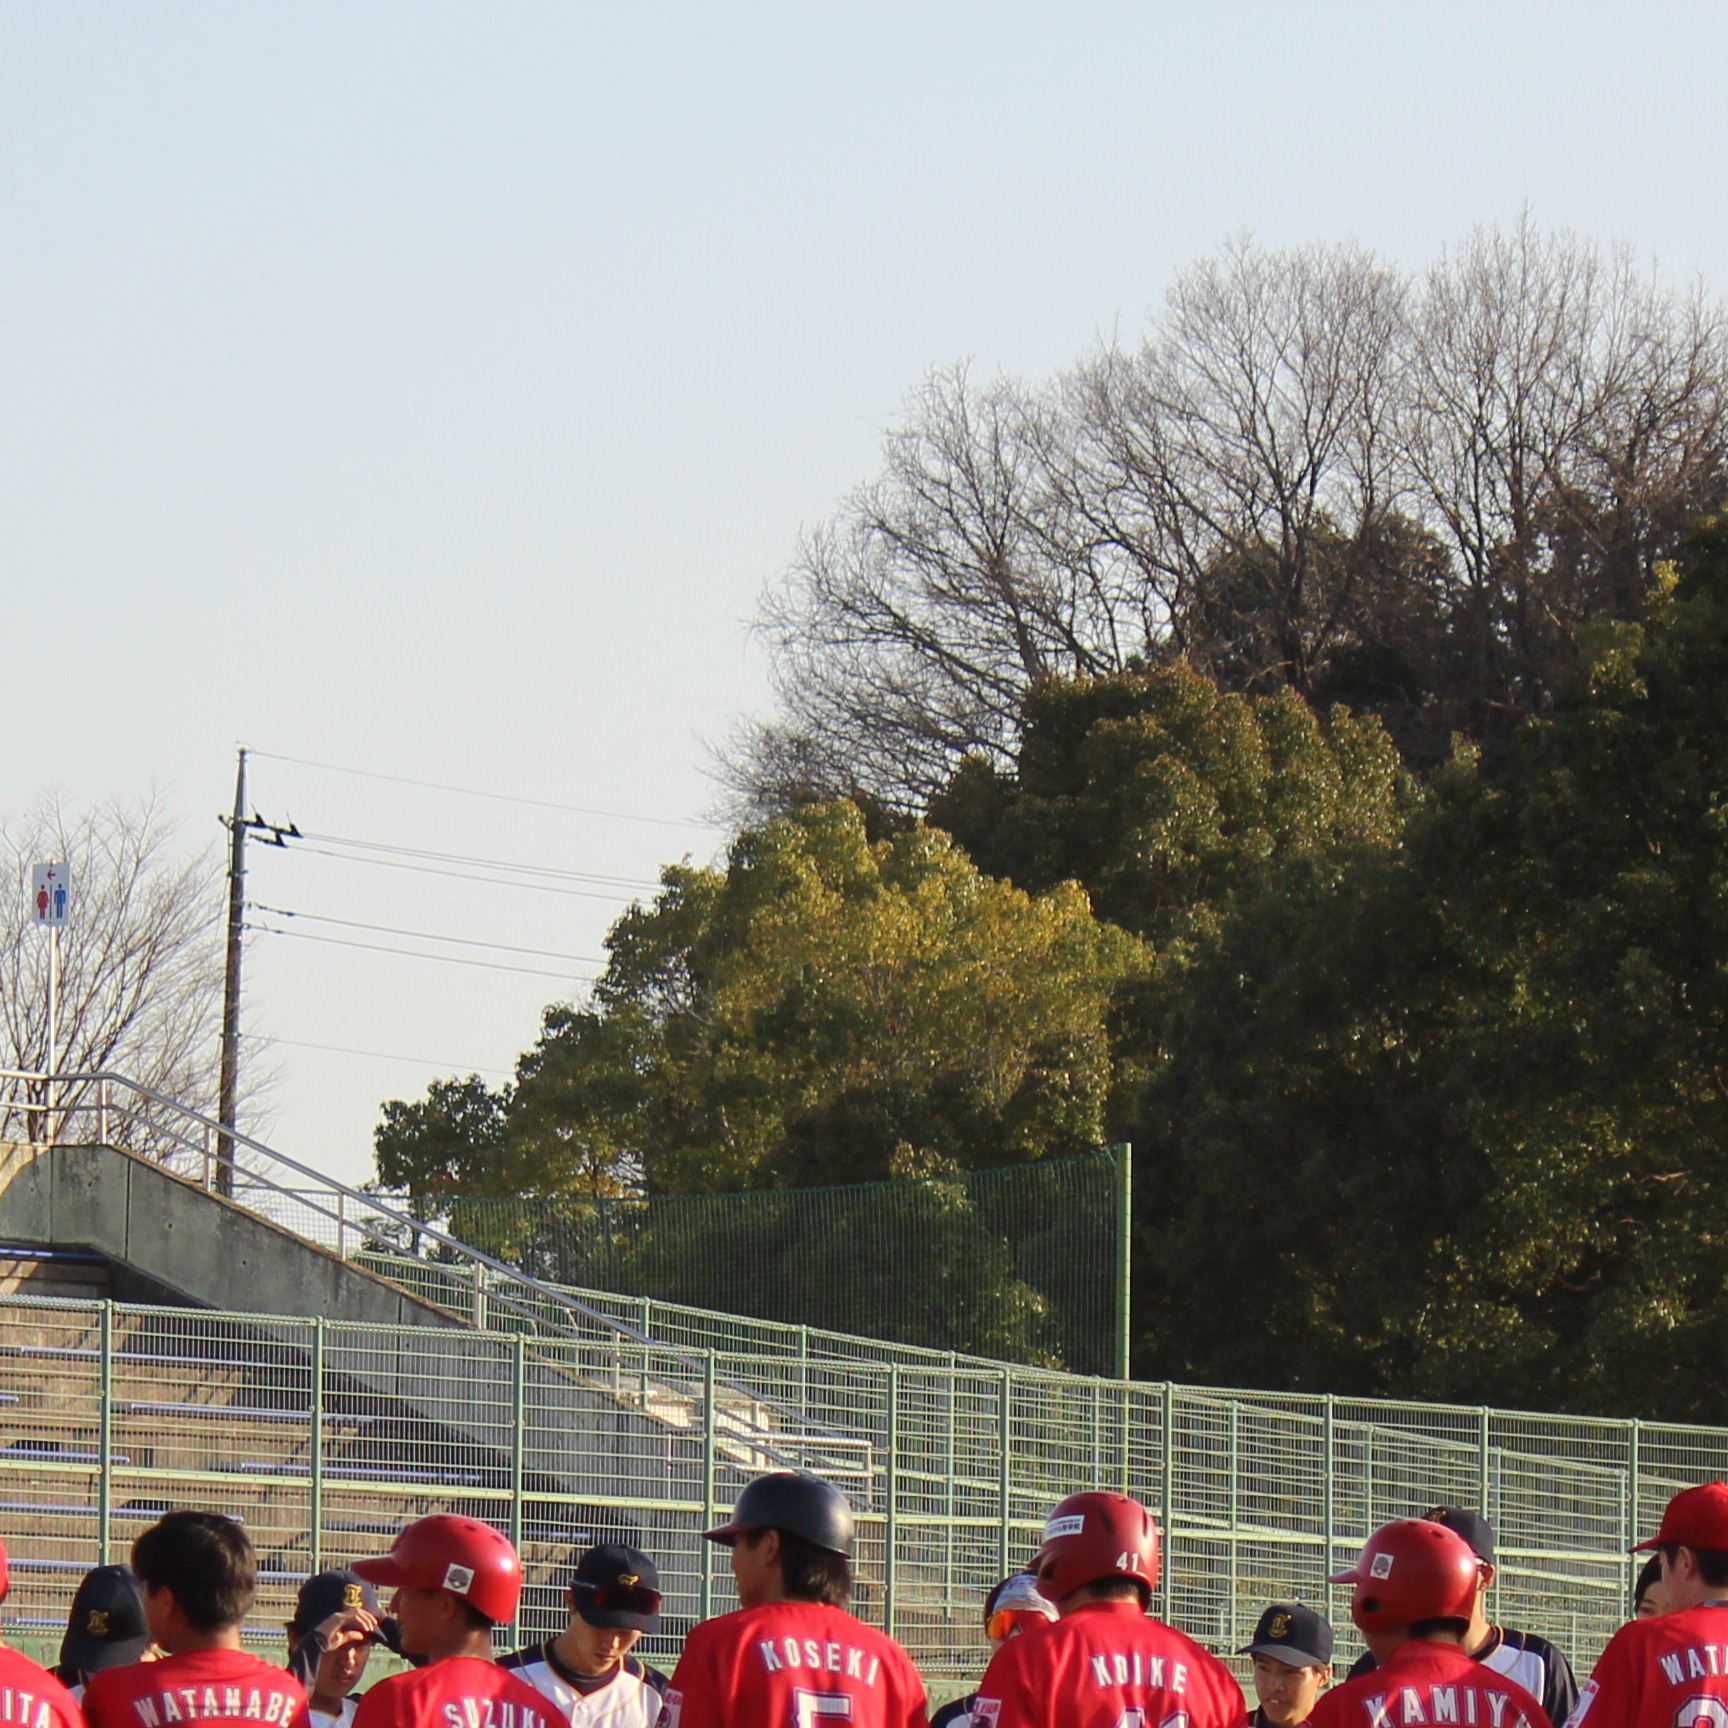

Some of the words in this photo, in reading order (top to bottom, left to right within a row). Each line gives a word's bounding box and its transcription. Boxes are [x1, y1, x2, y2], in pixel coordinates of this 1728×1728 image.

[1115, 1551, 1139, 1573] 41
[760, 1638, 879, 1686] KOSEKI
[1091, 1655, 1188, 1694] KOIKE
